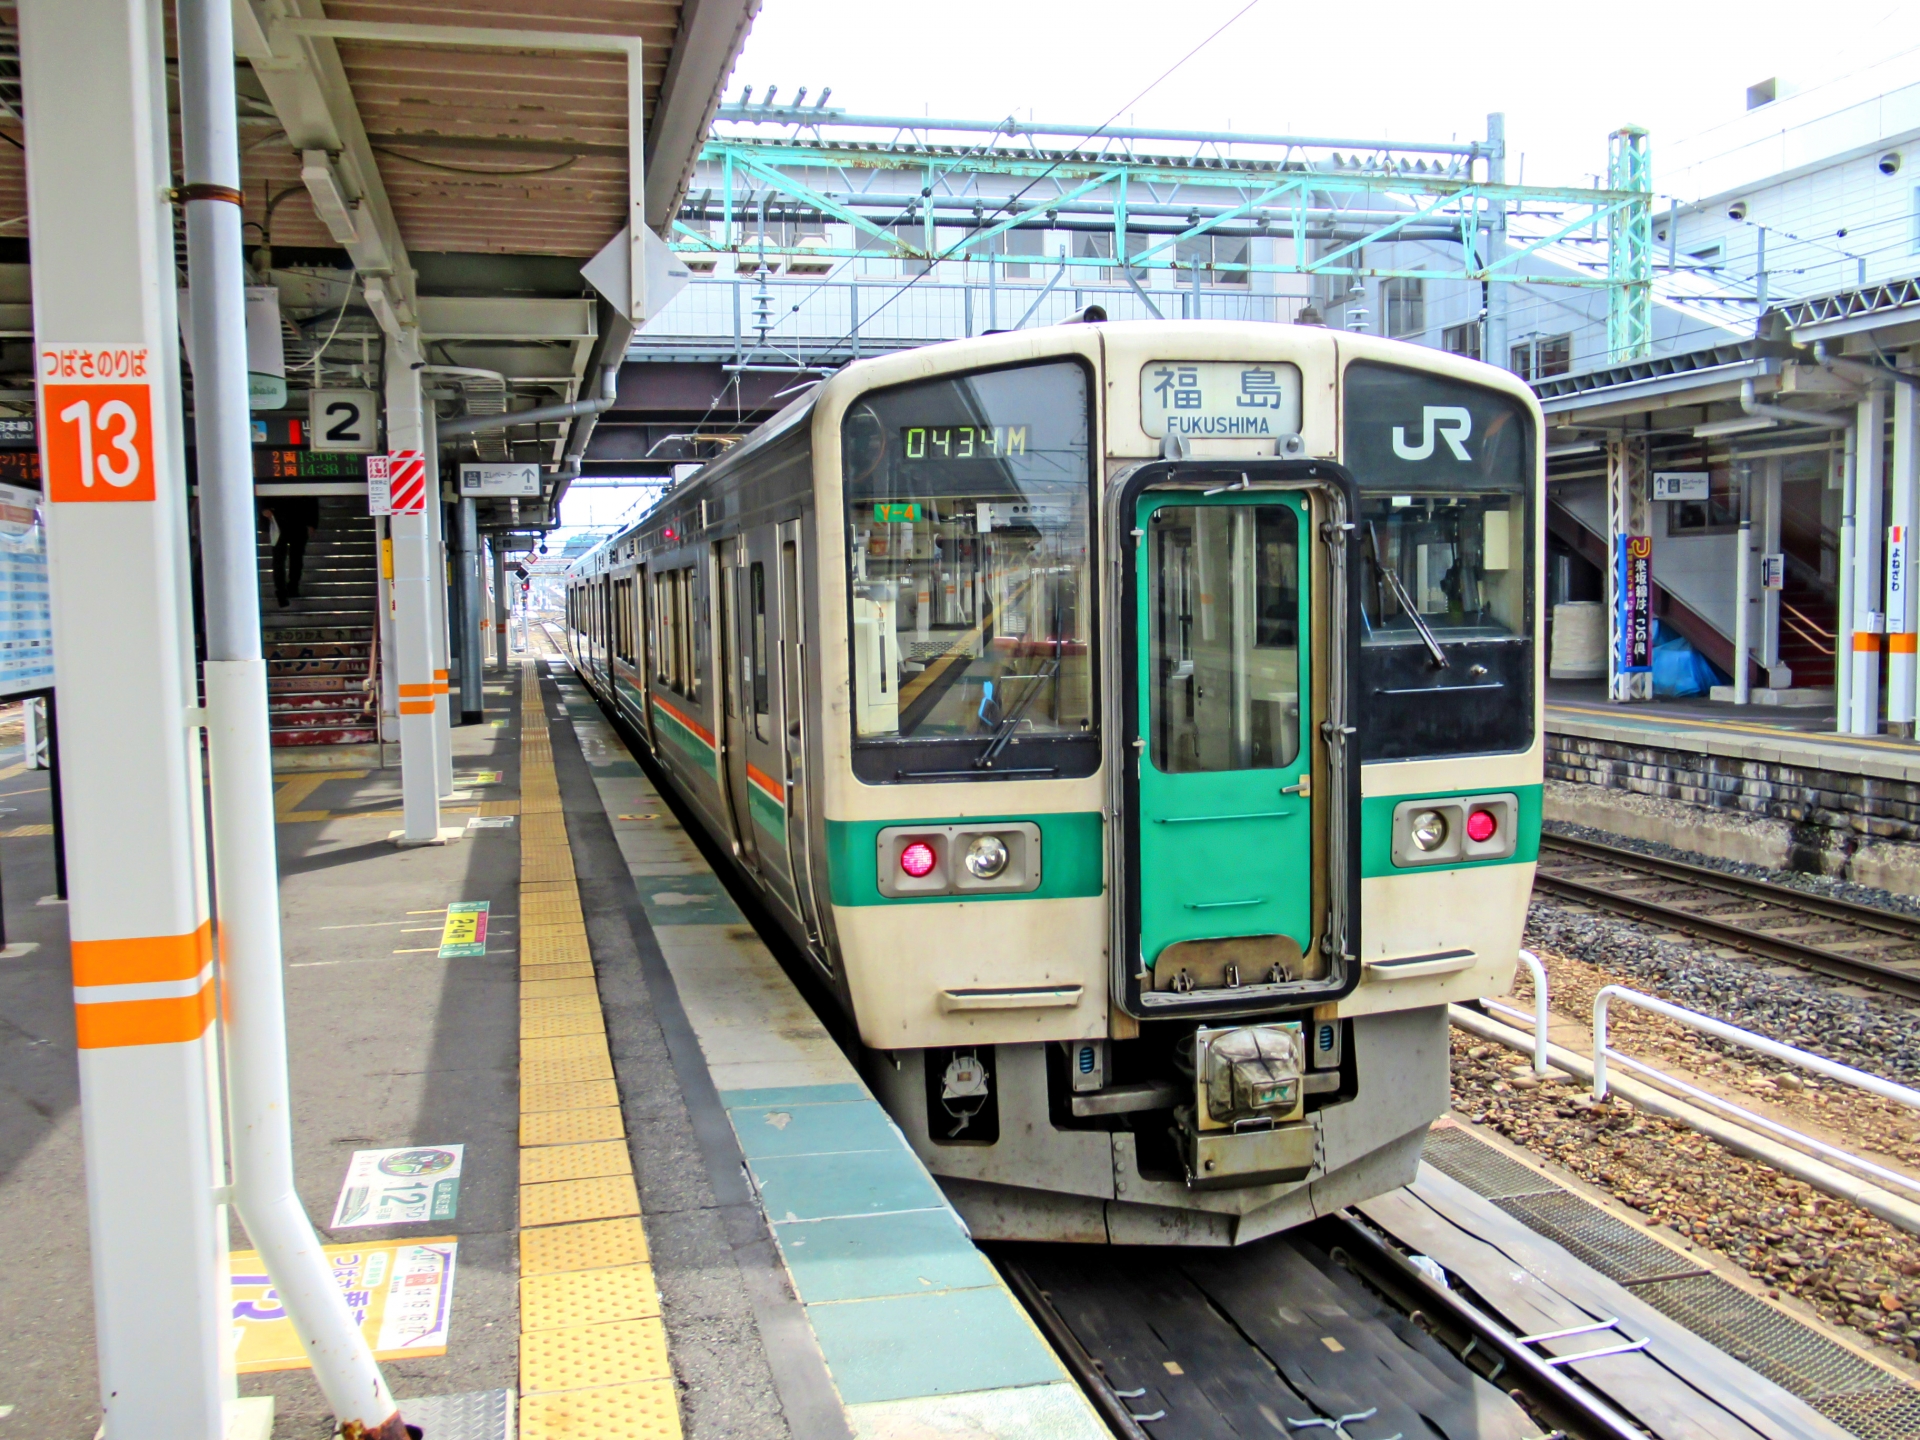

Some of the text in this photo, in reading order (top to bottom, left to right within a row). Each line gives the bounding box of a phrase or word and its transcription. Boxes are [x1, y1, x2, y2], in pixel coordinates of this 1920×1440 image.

[43, 349, 147, 378] つばさのりば
[1153, 366, 1281, 409] 福島
[325, 402, 361, 441] 2
[1167, 416, 1270, 434] FUKUSHIMA
[1392, 405, 1472, 461] JR
[60, 399, 140, 488] 13
[907, 426, 1026, 458] 0434M
[301, 463, 339, 476] 14:38
[880, 504, 915, 521] Y-4
[1261, 1085, 1288, 1101] JR
[380, 1182, 428, 1206] 12
